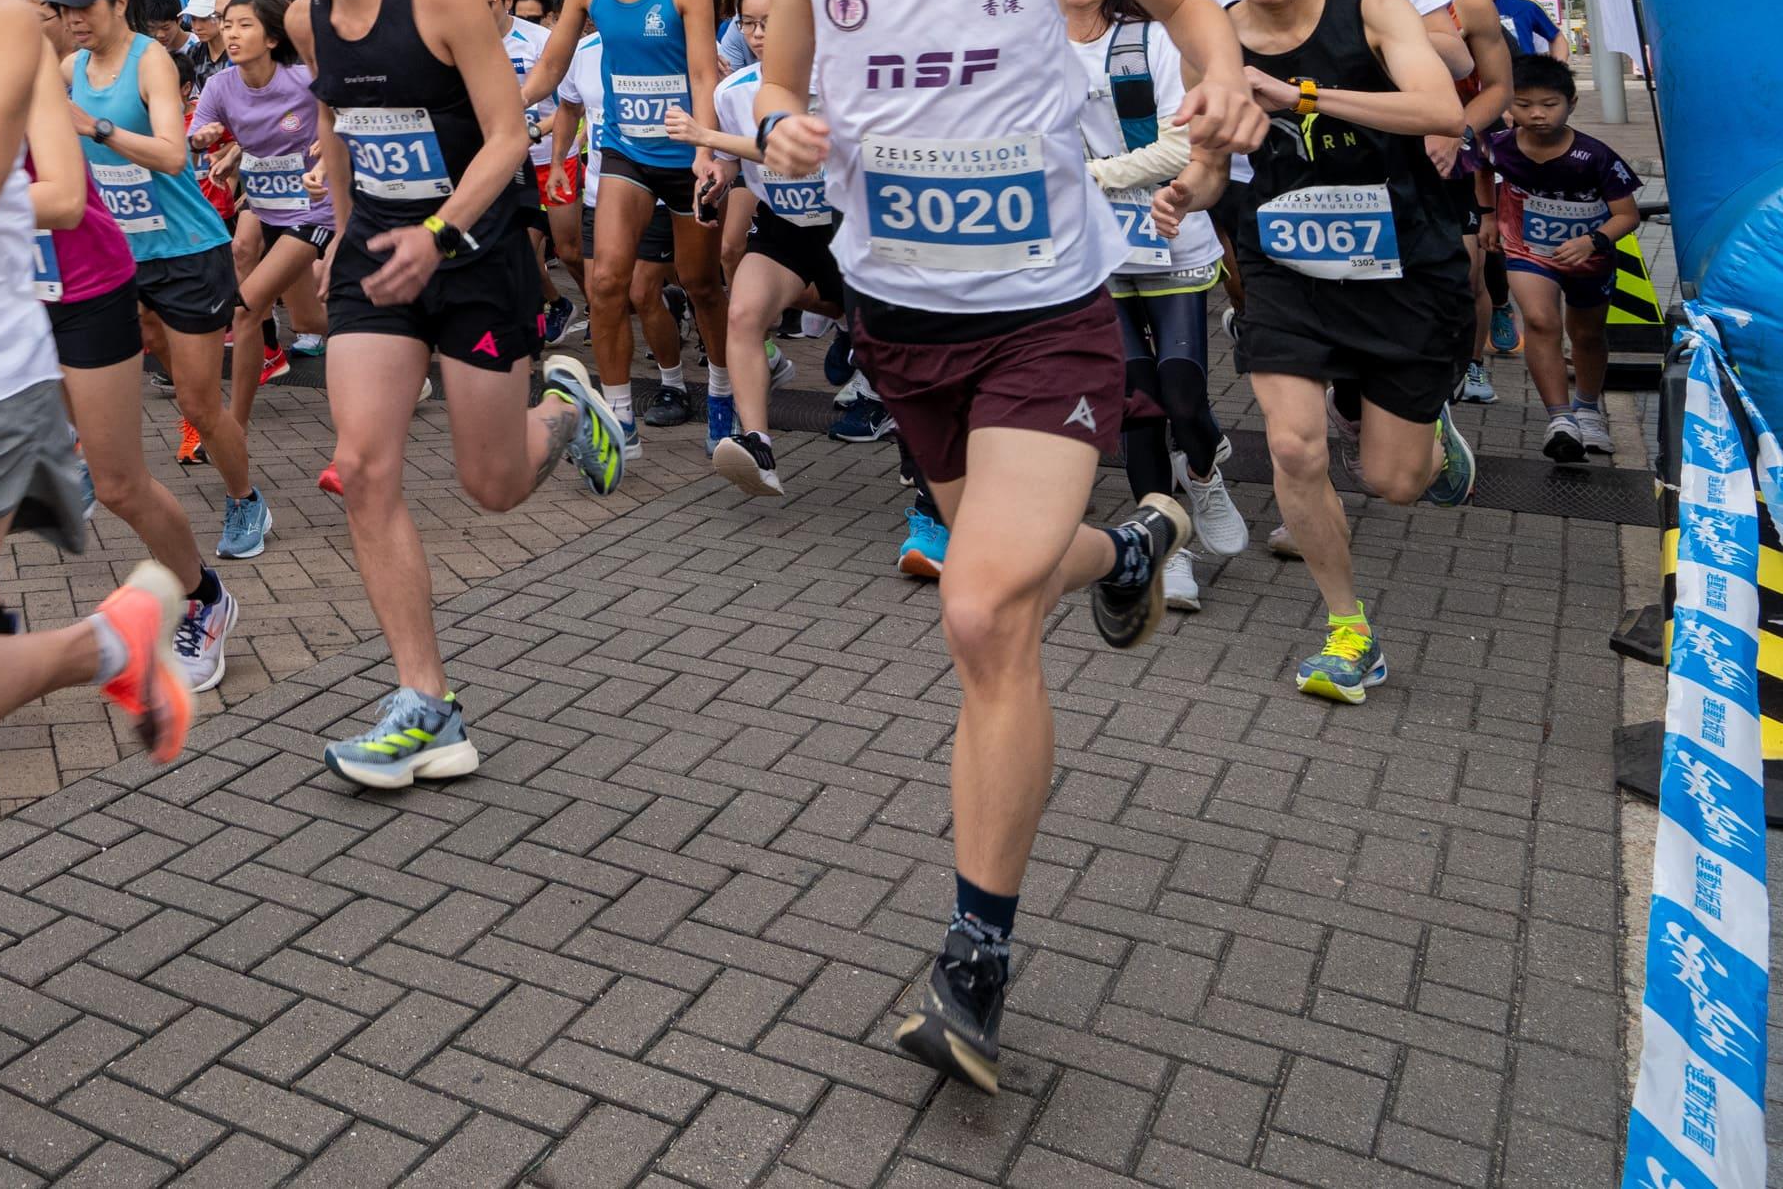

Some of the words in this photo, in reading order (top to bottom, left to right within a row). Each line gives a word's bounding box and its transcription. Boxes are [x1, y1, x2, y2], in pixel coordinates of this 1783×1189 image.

[348, 139, 432, 175] 3031
[246, 174, 303, 195] 4208
[879, 184, 1034, 234] 3020
[1116, 209, 1158, 241] 74
[1269, 219, 1382, 253] 3067
[1350, 258, 1376, 268] 3302
[1682, 1059, 1717, 1158] 運動版圖
